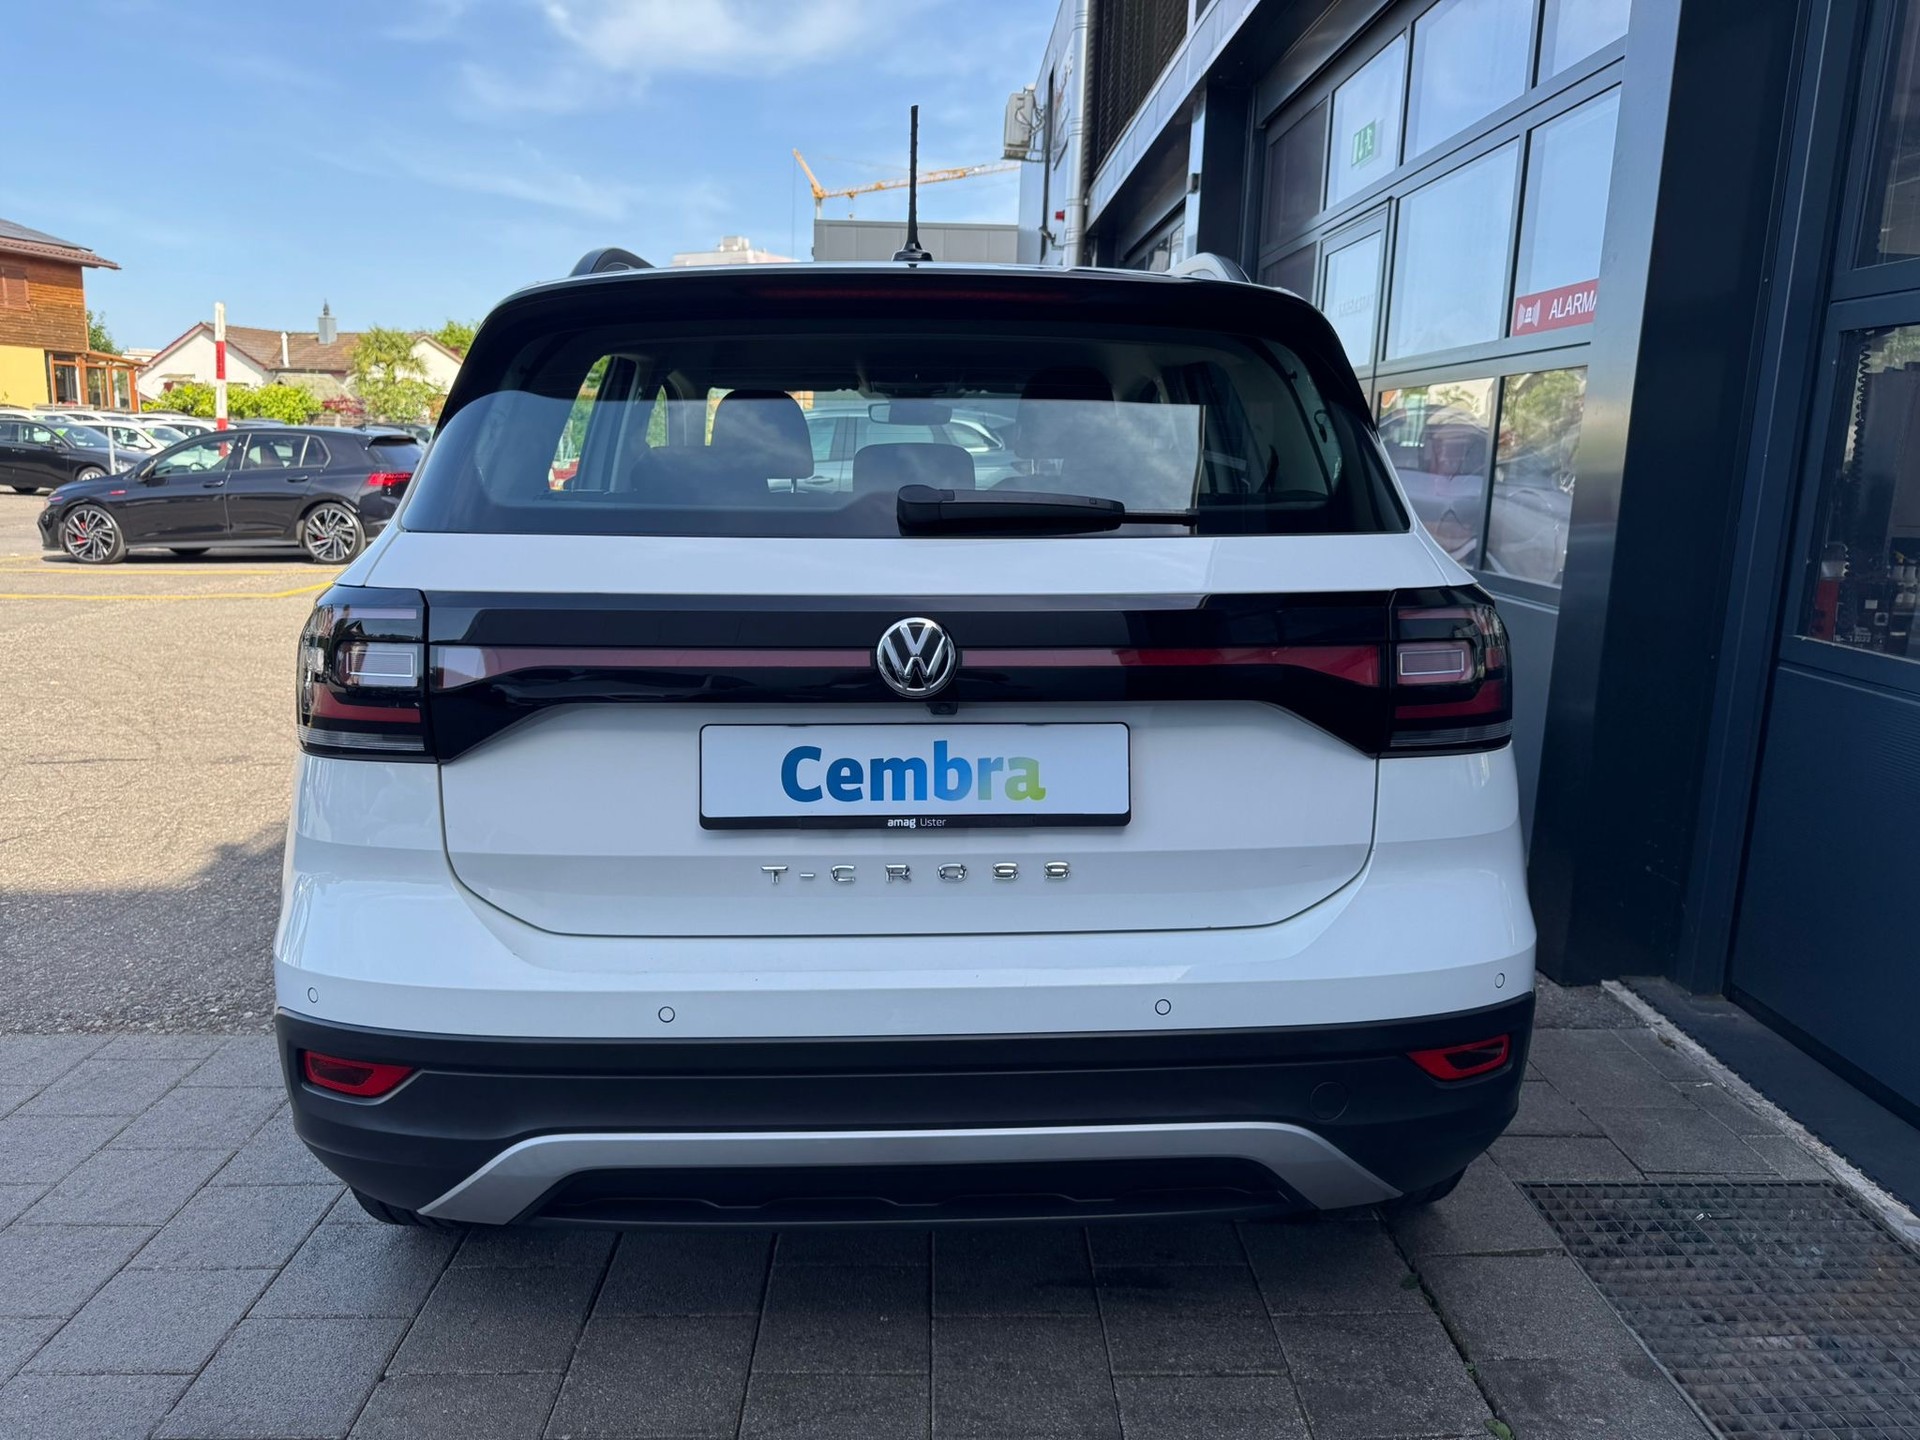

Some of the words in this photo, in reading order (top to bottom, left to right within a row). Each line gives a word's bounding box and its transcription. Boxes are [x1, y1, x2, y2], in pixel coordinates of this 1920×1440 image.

[877, 617, 956, 697] VW
[781, 740, 1046, 803] Cembra
[887, 818, 916, 829] amag
[920, 818, 946, 827] Uster
[761, 861, 1071, 884] T-CROSS
